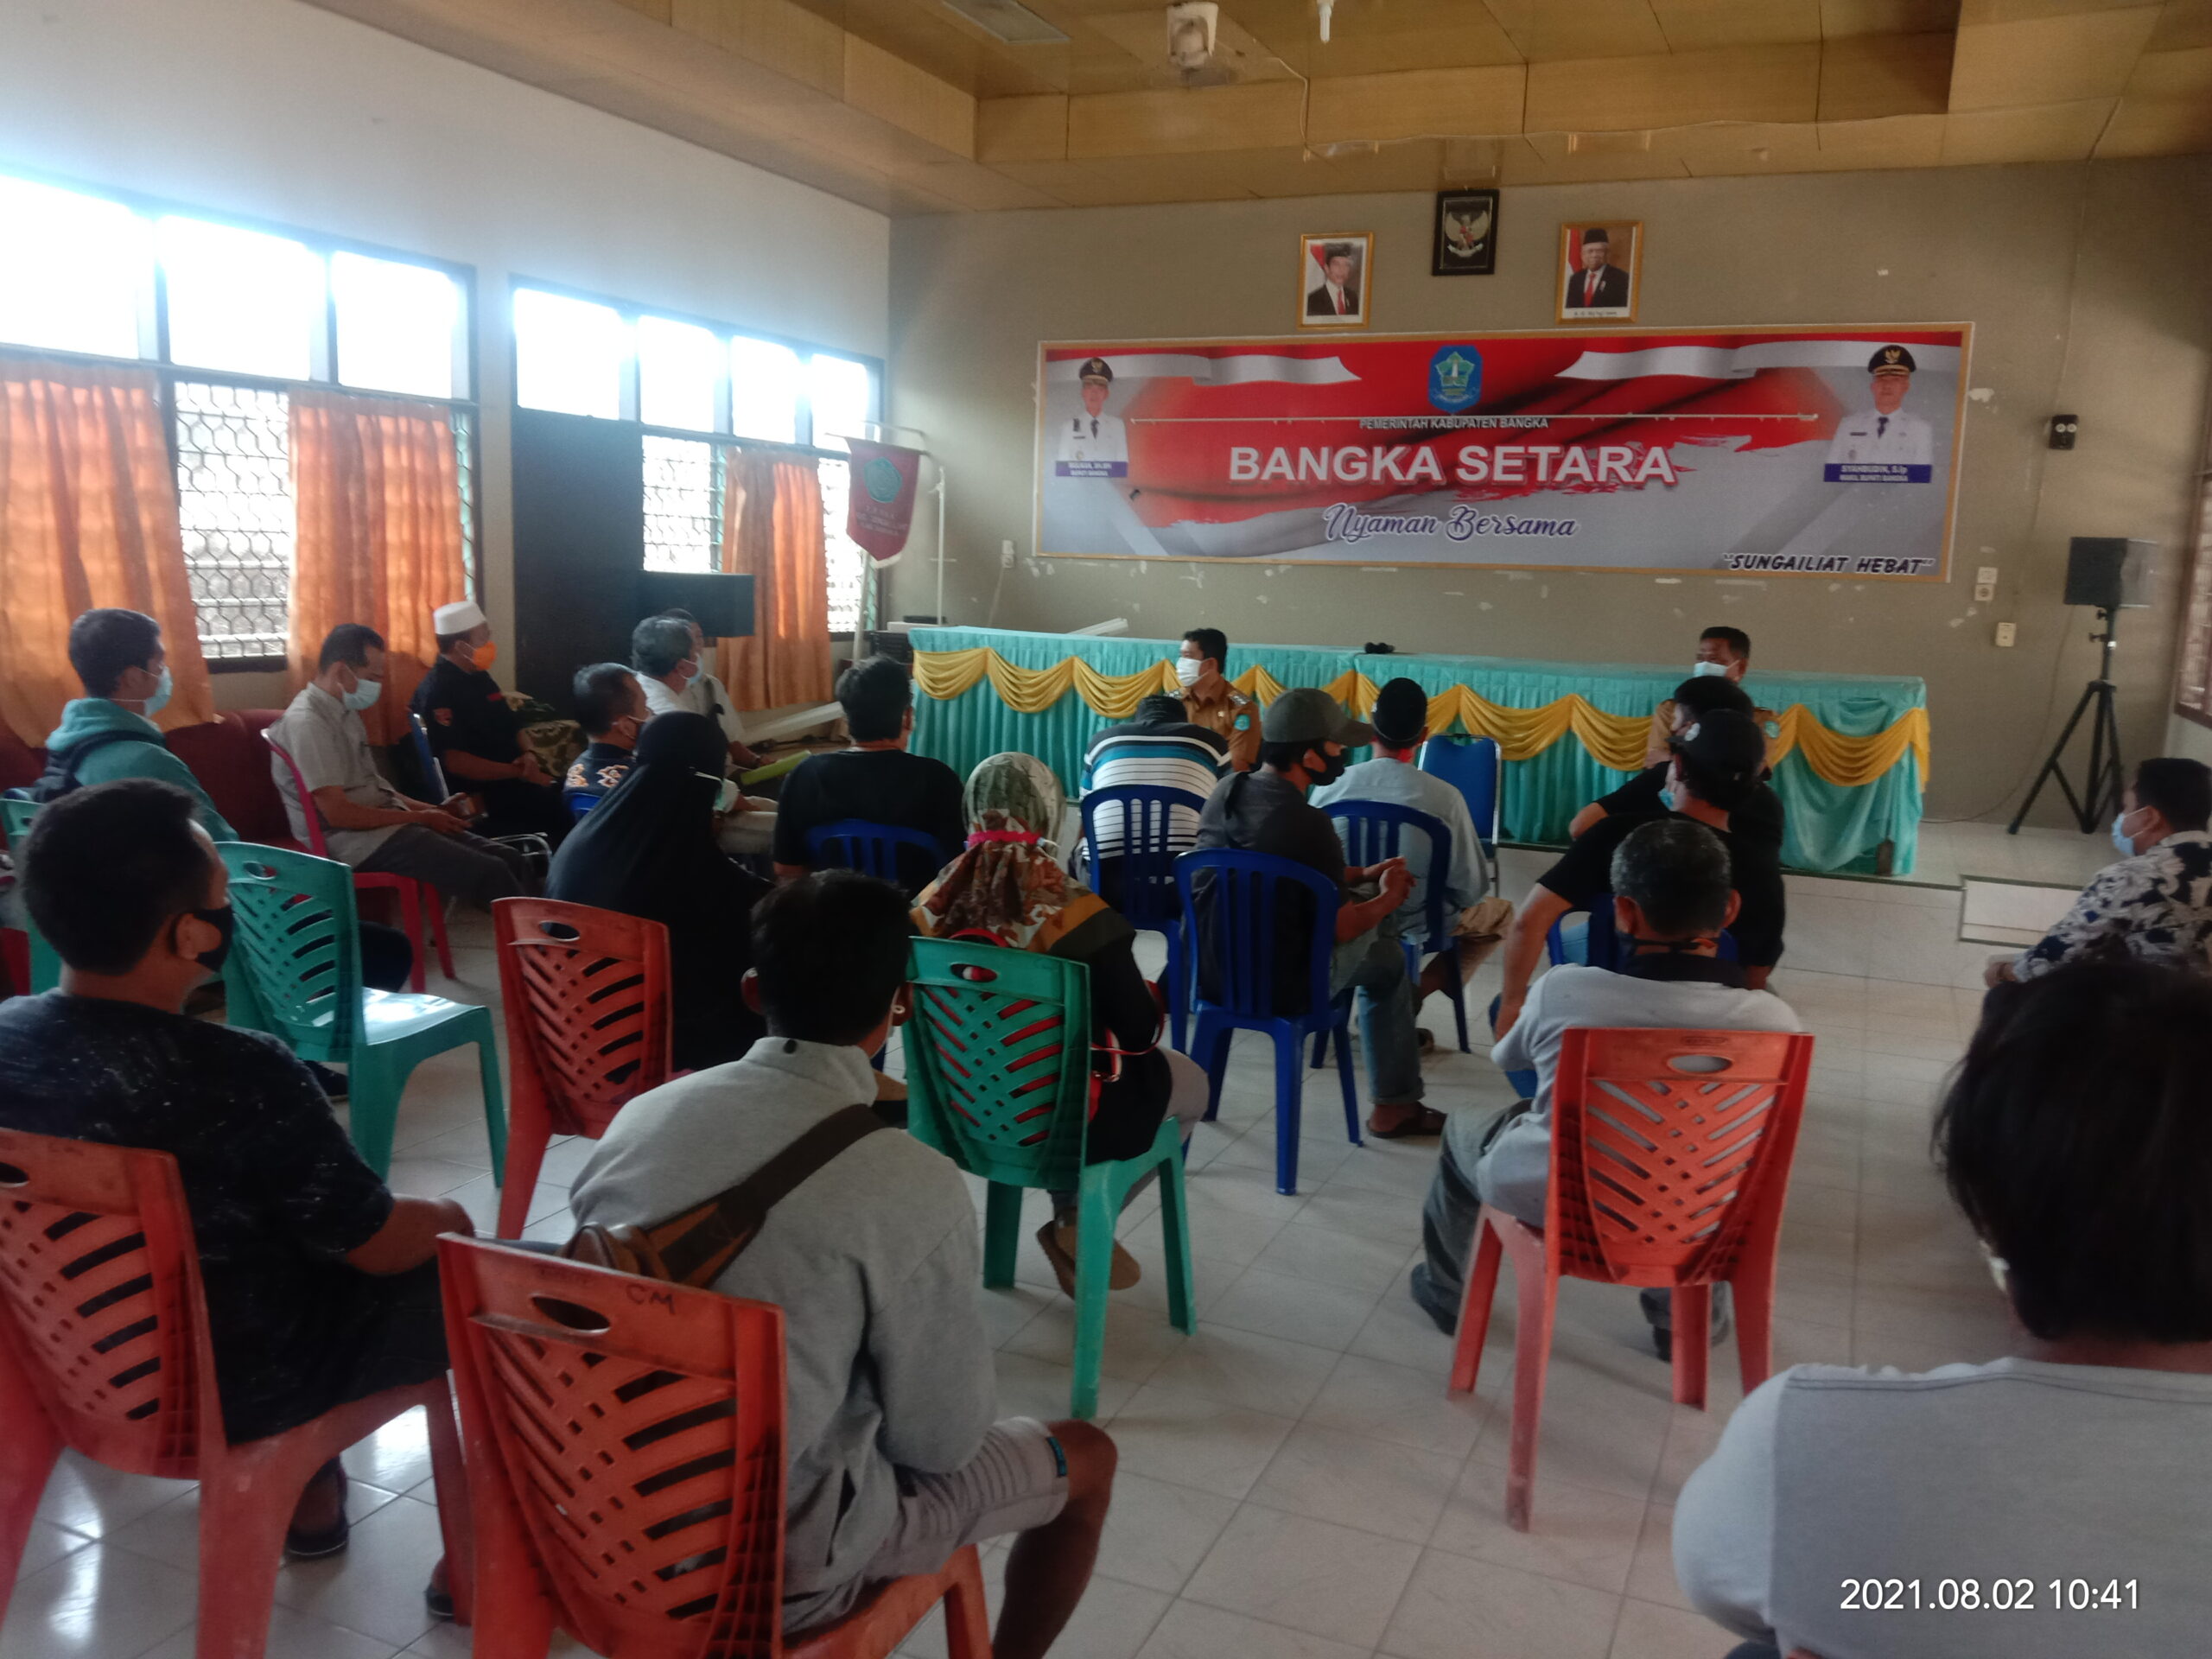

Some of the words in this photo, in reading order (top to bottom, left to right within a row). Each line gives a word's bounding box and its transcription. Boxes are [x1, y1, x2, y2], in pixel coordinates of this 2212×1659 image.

[1358, 417, 1428, 429] PEMERINTAH
[1430, 416, 1497, 429] KABUPATEN
[1500, 416, 1549, 429] BANGKA
[1229, 445, 1445, 483] BANGKA
[1455, 444, 1677, 484] SETARA
[1324, 503, 1439, 543] Nyaman
[1446, 505, 1577, 542] Bersama
